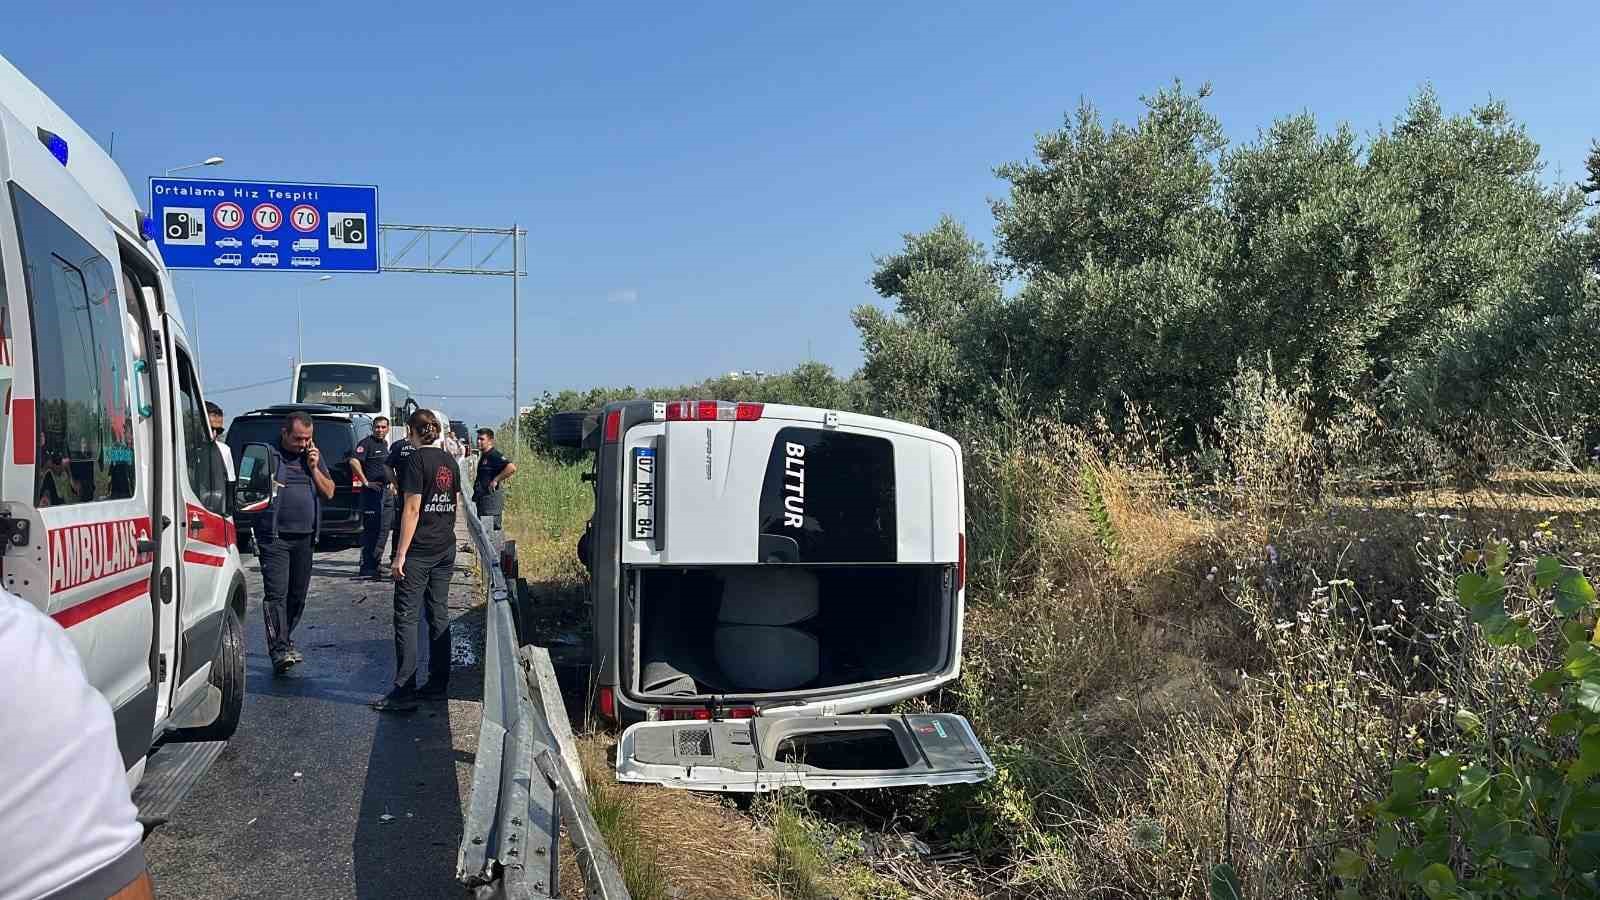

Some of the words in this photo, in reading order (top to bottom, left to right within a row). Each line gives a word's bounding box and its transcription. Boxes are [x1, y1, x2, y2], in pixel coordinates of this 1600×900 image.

[154, 185, 225, 197] Ortalama
[268, 189, 319, 200] Tespiti
[220, 208, 238, 223] 70
[259, 209, 276, 224] 70
[297, 210, 315, 225] 70
[638, 458, 653, 475] 07
[638, 482, 653, 506] MKR
[783, 442, 805, 529] BLTTUR
[637, 518, 652, 535] 84
[51, 520, 137, 592] AMBULANS
